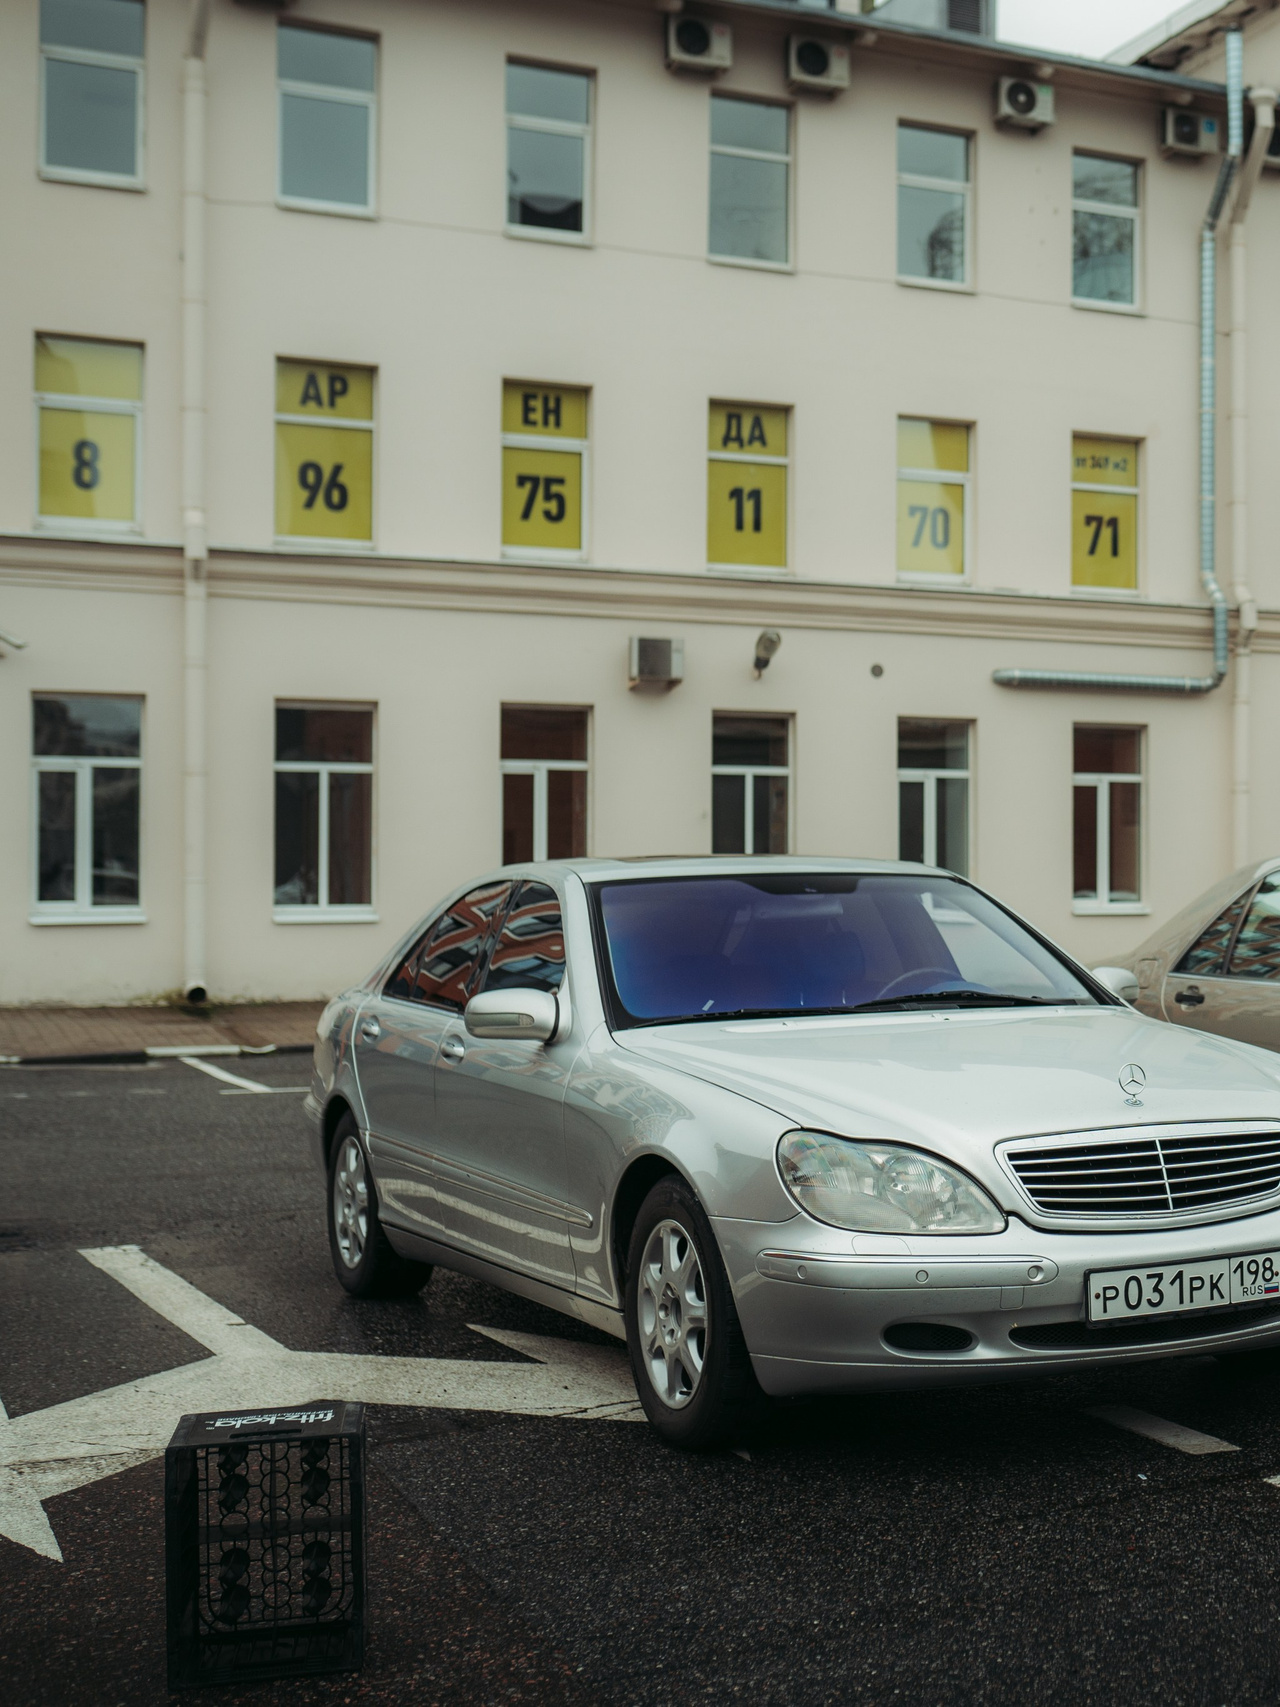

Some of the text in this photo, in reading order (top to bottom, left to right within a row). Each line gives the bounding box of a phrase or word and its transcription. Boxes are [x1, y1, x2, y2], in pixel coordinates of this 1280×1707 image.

[299, 373, 768, 449] АР ЕН ДА
[72, 439, 1119, 558] 8 96 75 11 70 71
[1102, 1256, 1275, 1314] Р031РК 198
[1242, 1284, 1263, 1297] RUS
[214, 1412, 334, 1428] fritz-kola
